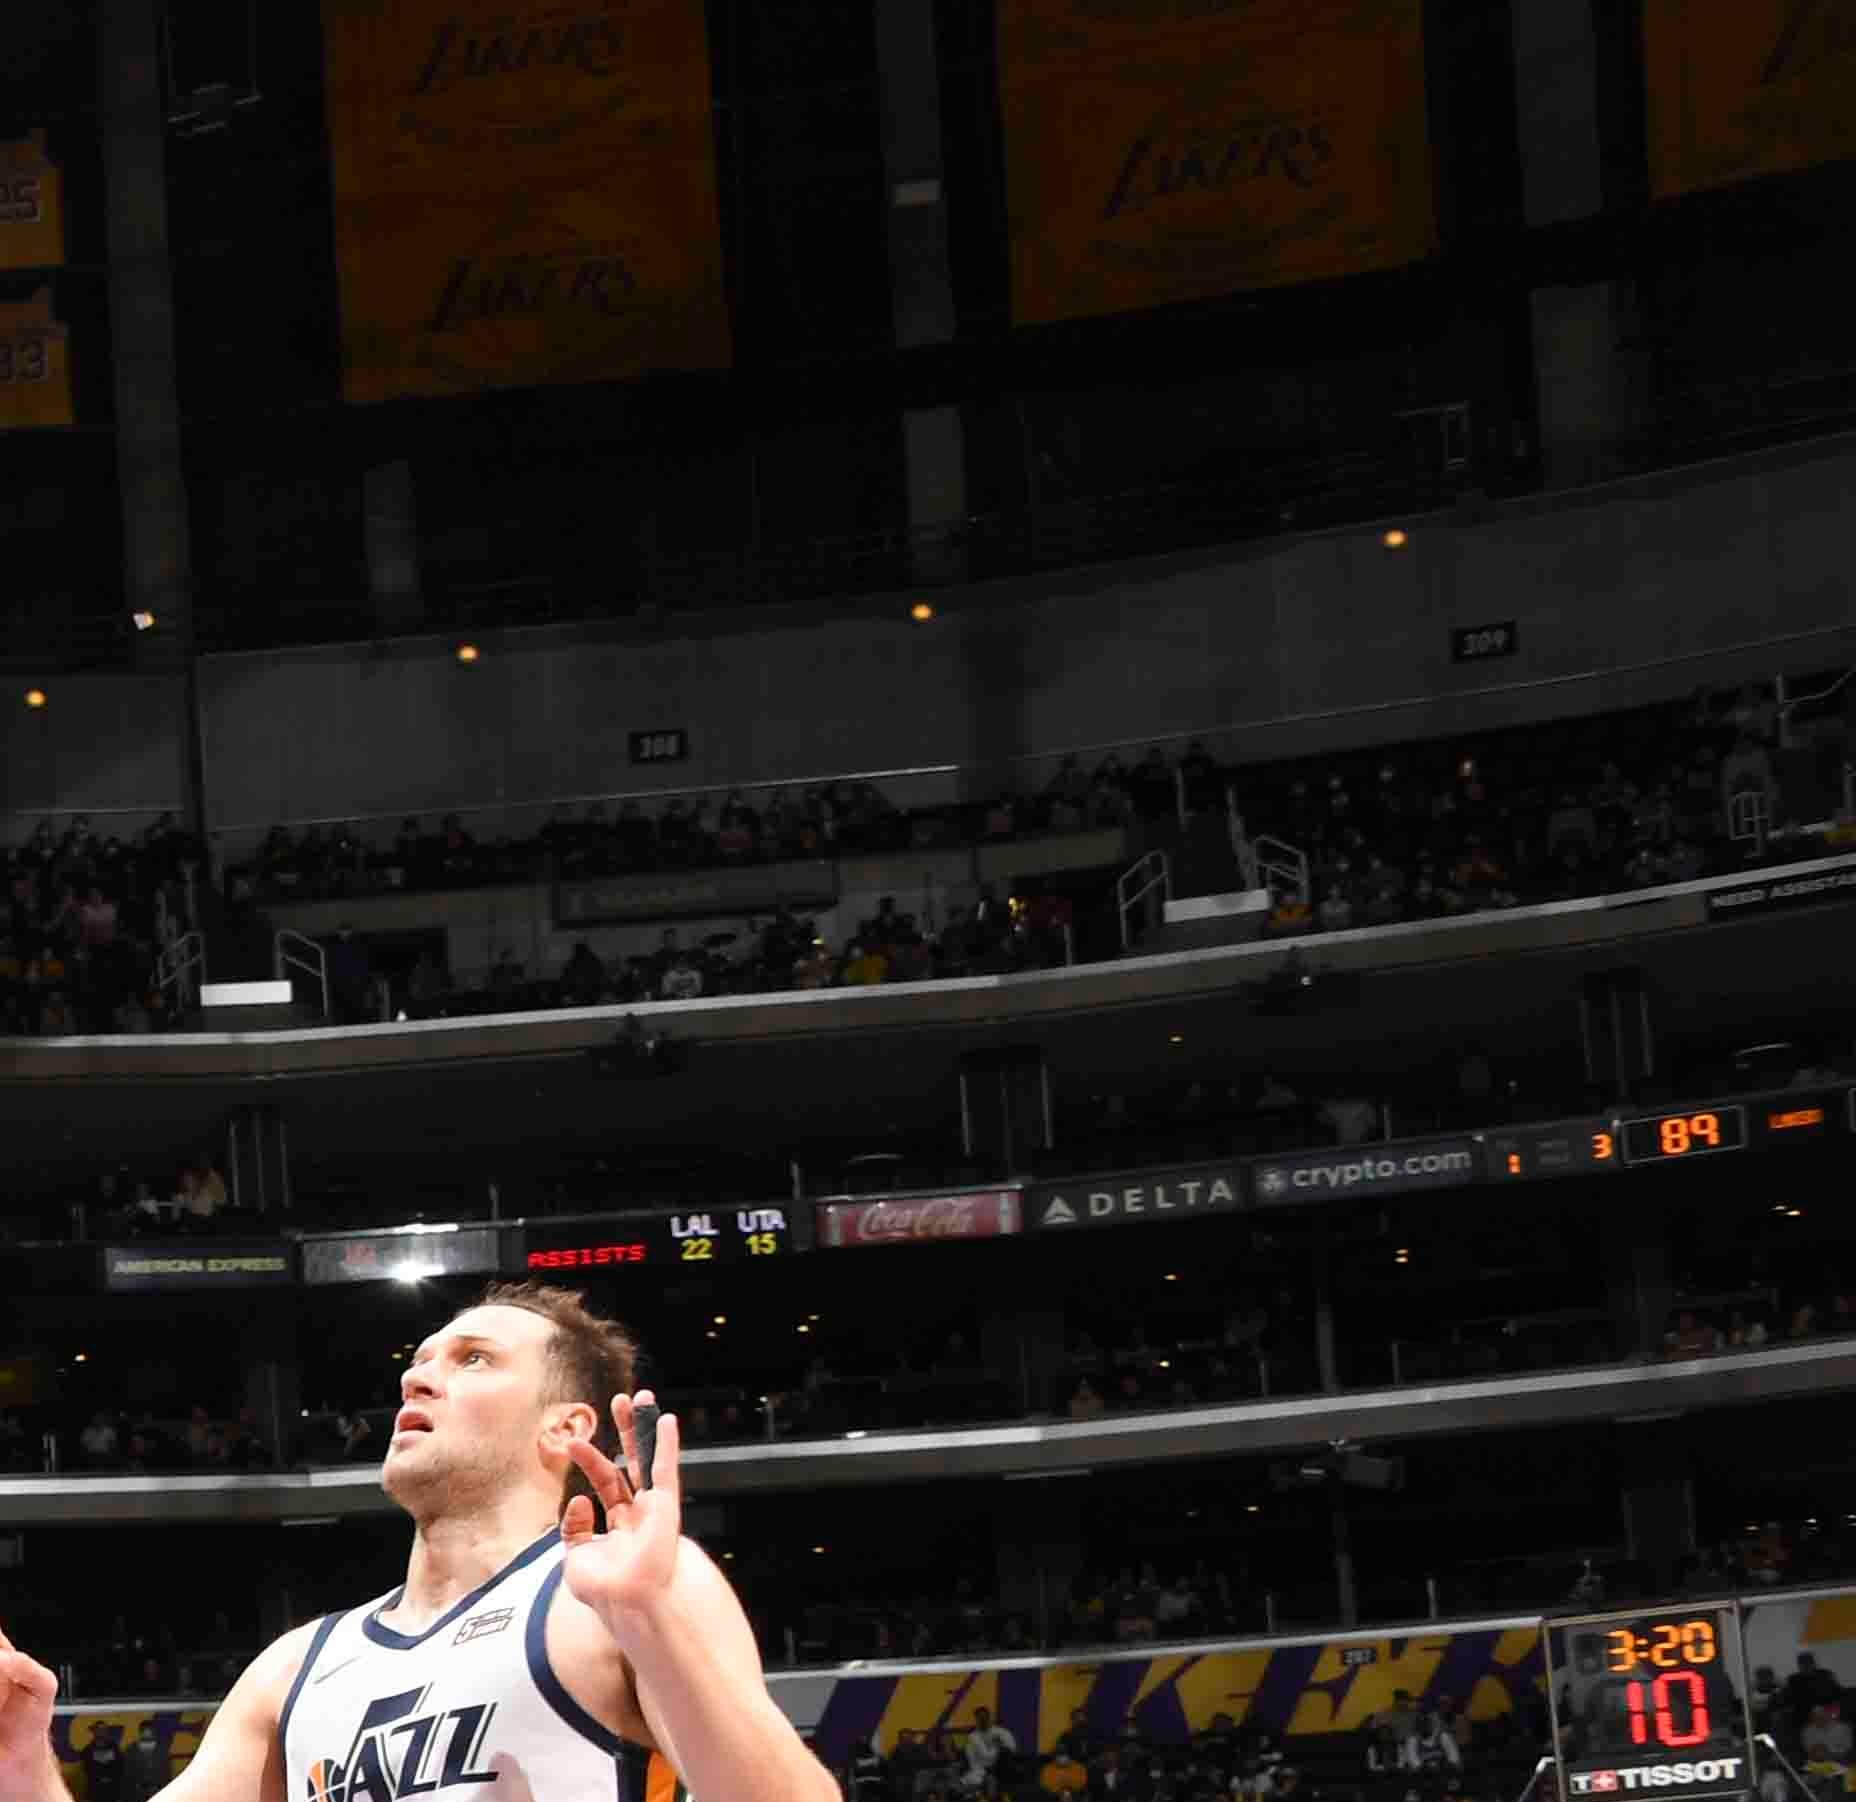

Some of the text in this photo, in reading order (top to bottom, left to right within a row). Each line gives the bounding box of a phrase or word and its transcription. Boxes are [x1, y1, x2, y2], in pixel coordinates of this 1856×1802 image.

[1591, 1133, 1615, 1161] 3
[1659, 1111, 1723, 1156] 89
[1291, 1149, 1473, 1191] crypto.com
[1089, 1176, 1234, 1219] DELTA
[670, 1212, 719, 1238] LAL
[736, 1207, 786, 1233] UTA
[1605, 1620, 1717, 1672] 3:20
[1625, 1670, 1711, 1746] 10
[1617, 1758, 1742, 1789] TISSOT
